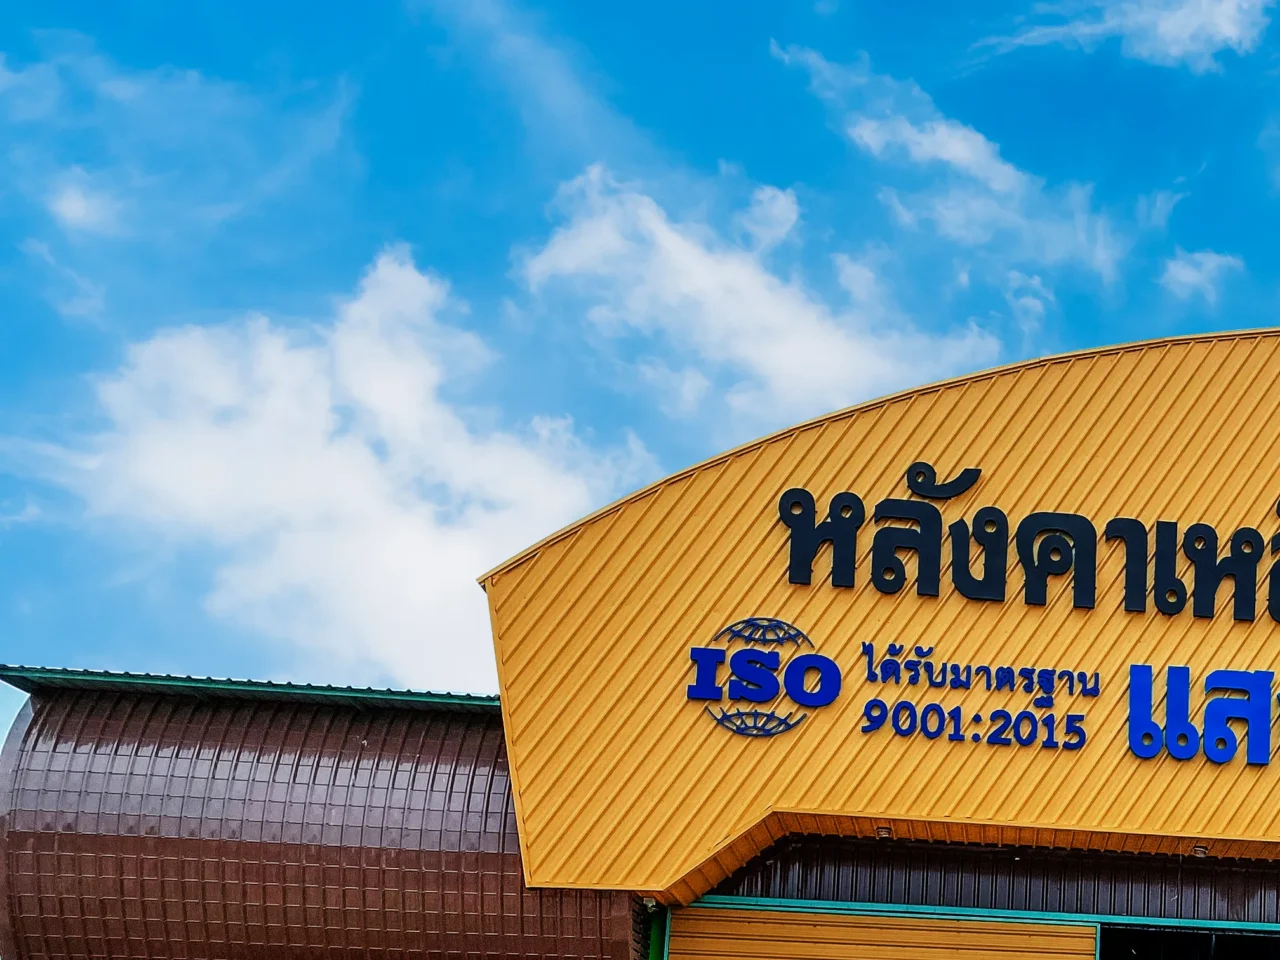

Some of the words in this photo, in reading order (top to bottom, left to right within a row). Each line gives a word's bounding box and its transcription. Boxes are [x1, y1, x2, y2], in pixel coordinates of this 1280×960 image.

[687, 647, 842, 707] ISO
[862, 641, 1100, 708] ได้รับมาตรฐาน
[861, 699, 1088, 750] 9001:2015
